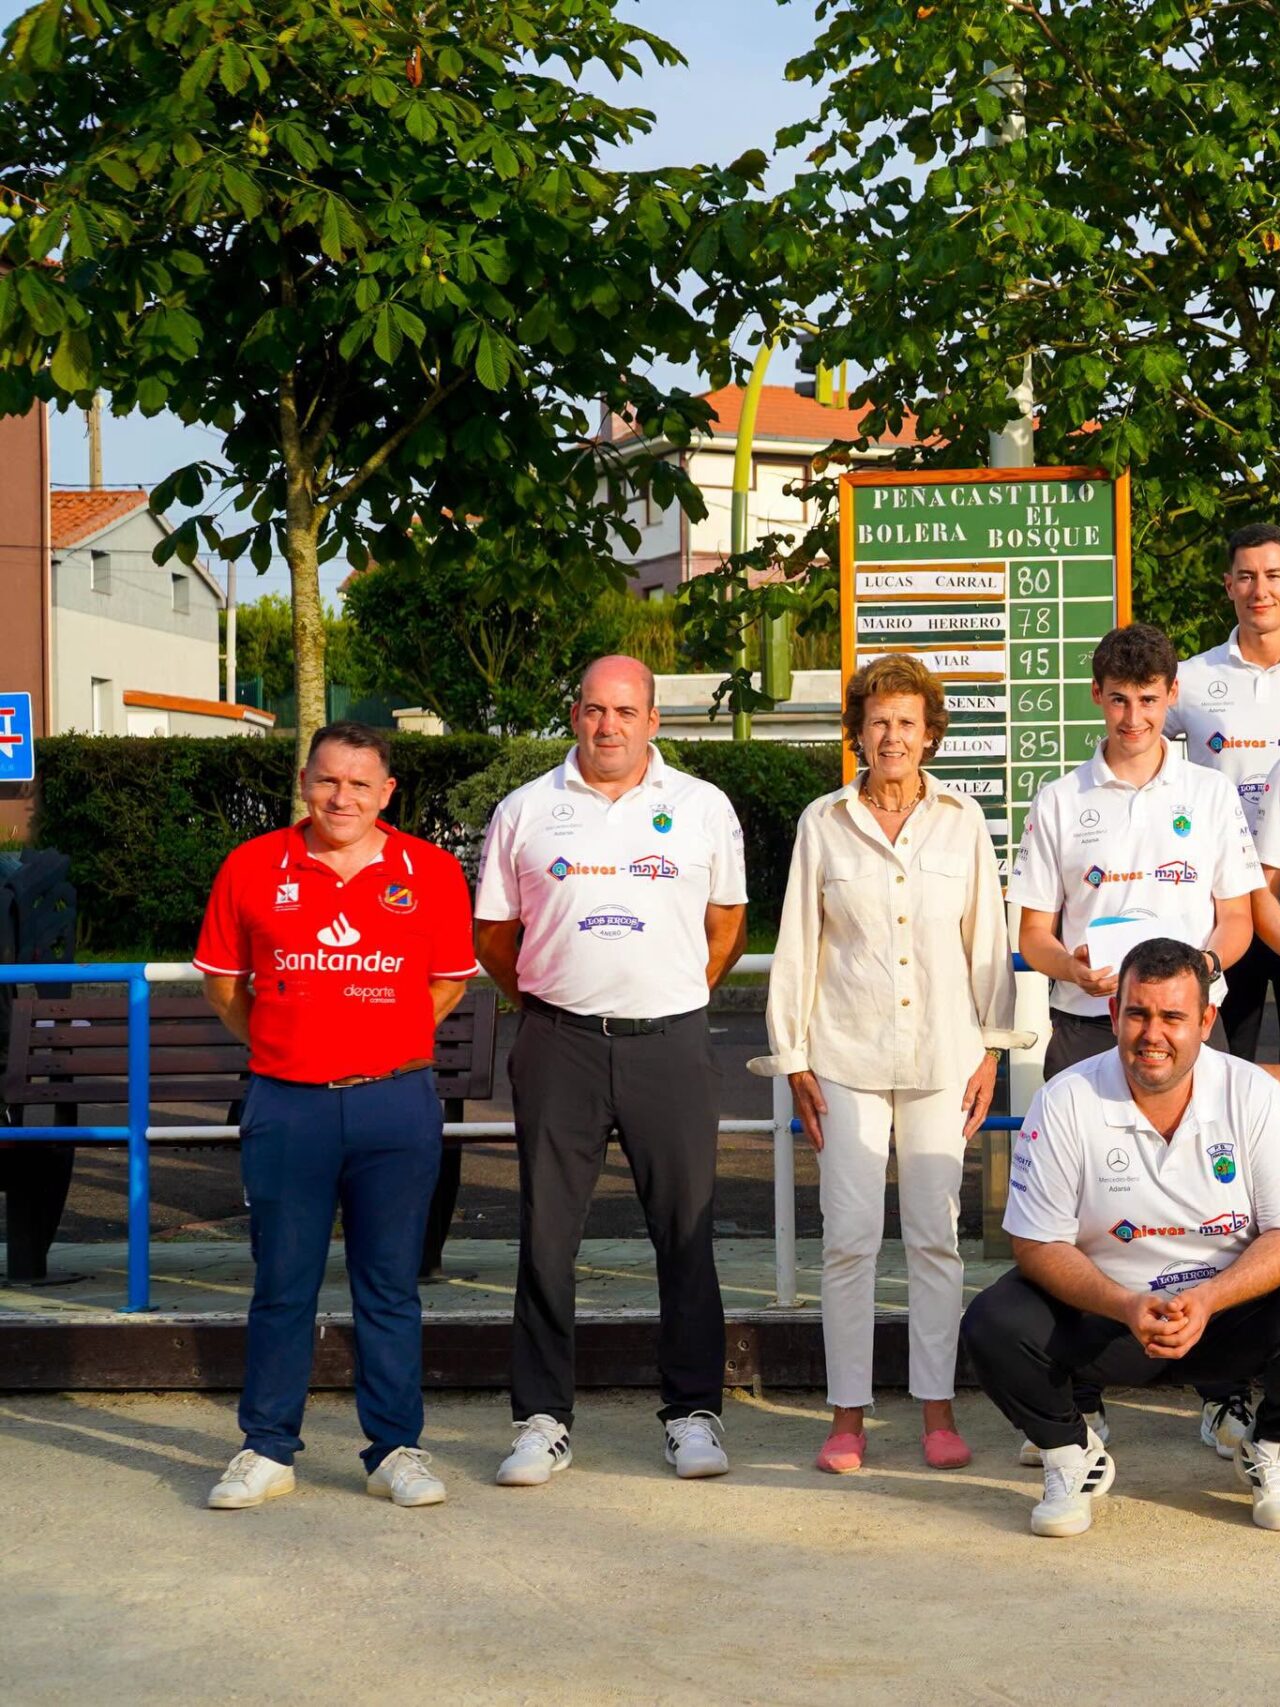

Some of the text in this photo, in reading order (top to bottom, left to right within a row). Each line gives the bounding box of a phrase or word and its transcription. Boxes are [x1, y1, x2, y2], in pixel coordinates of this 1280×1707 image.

[873, 483, 1095, 509] PEÑACASTILLO
[1025, 506, 1060, 526] EL
[858, 522, 1100, 553] BOLERA BOSQUE
[865, 575, 997, 588] LUCAS CARRAL
[1017, 566, 1051, 596] 80
[862, 616, 1001, 630] MARIO HERRERO
[1017, 608, 1051, 637] 78
[934, 655, 970, 666] VIAR
[1019, 647, 1050, 676] 95
[948, 697, 996, 708] SENEN
[1018, 688, 1053, 712] 66
[943, 740, 993, 751] ELLON
[1019, 731, 1059, 759] 85
[629, 855, 679, 880] mayba
[1155, 860, 1198, 885] mayba
[274, 948, 404, 973] Santander
[344, 984, 395, 1002] deporte
[1114, 1210, 1250, 1239] anievas mayba
